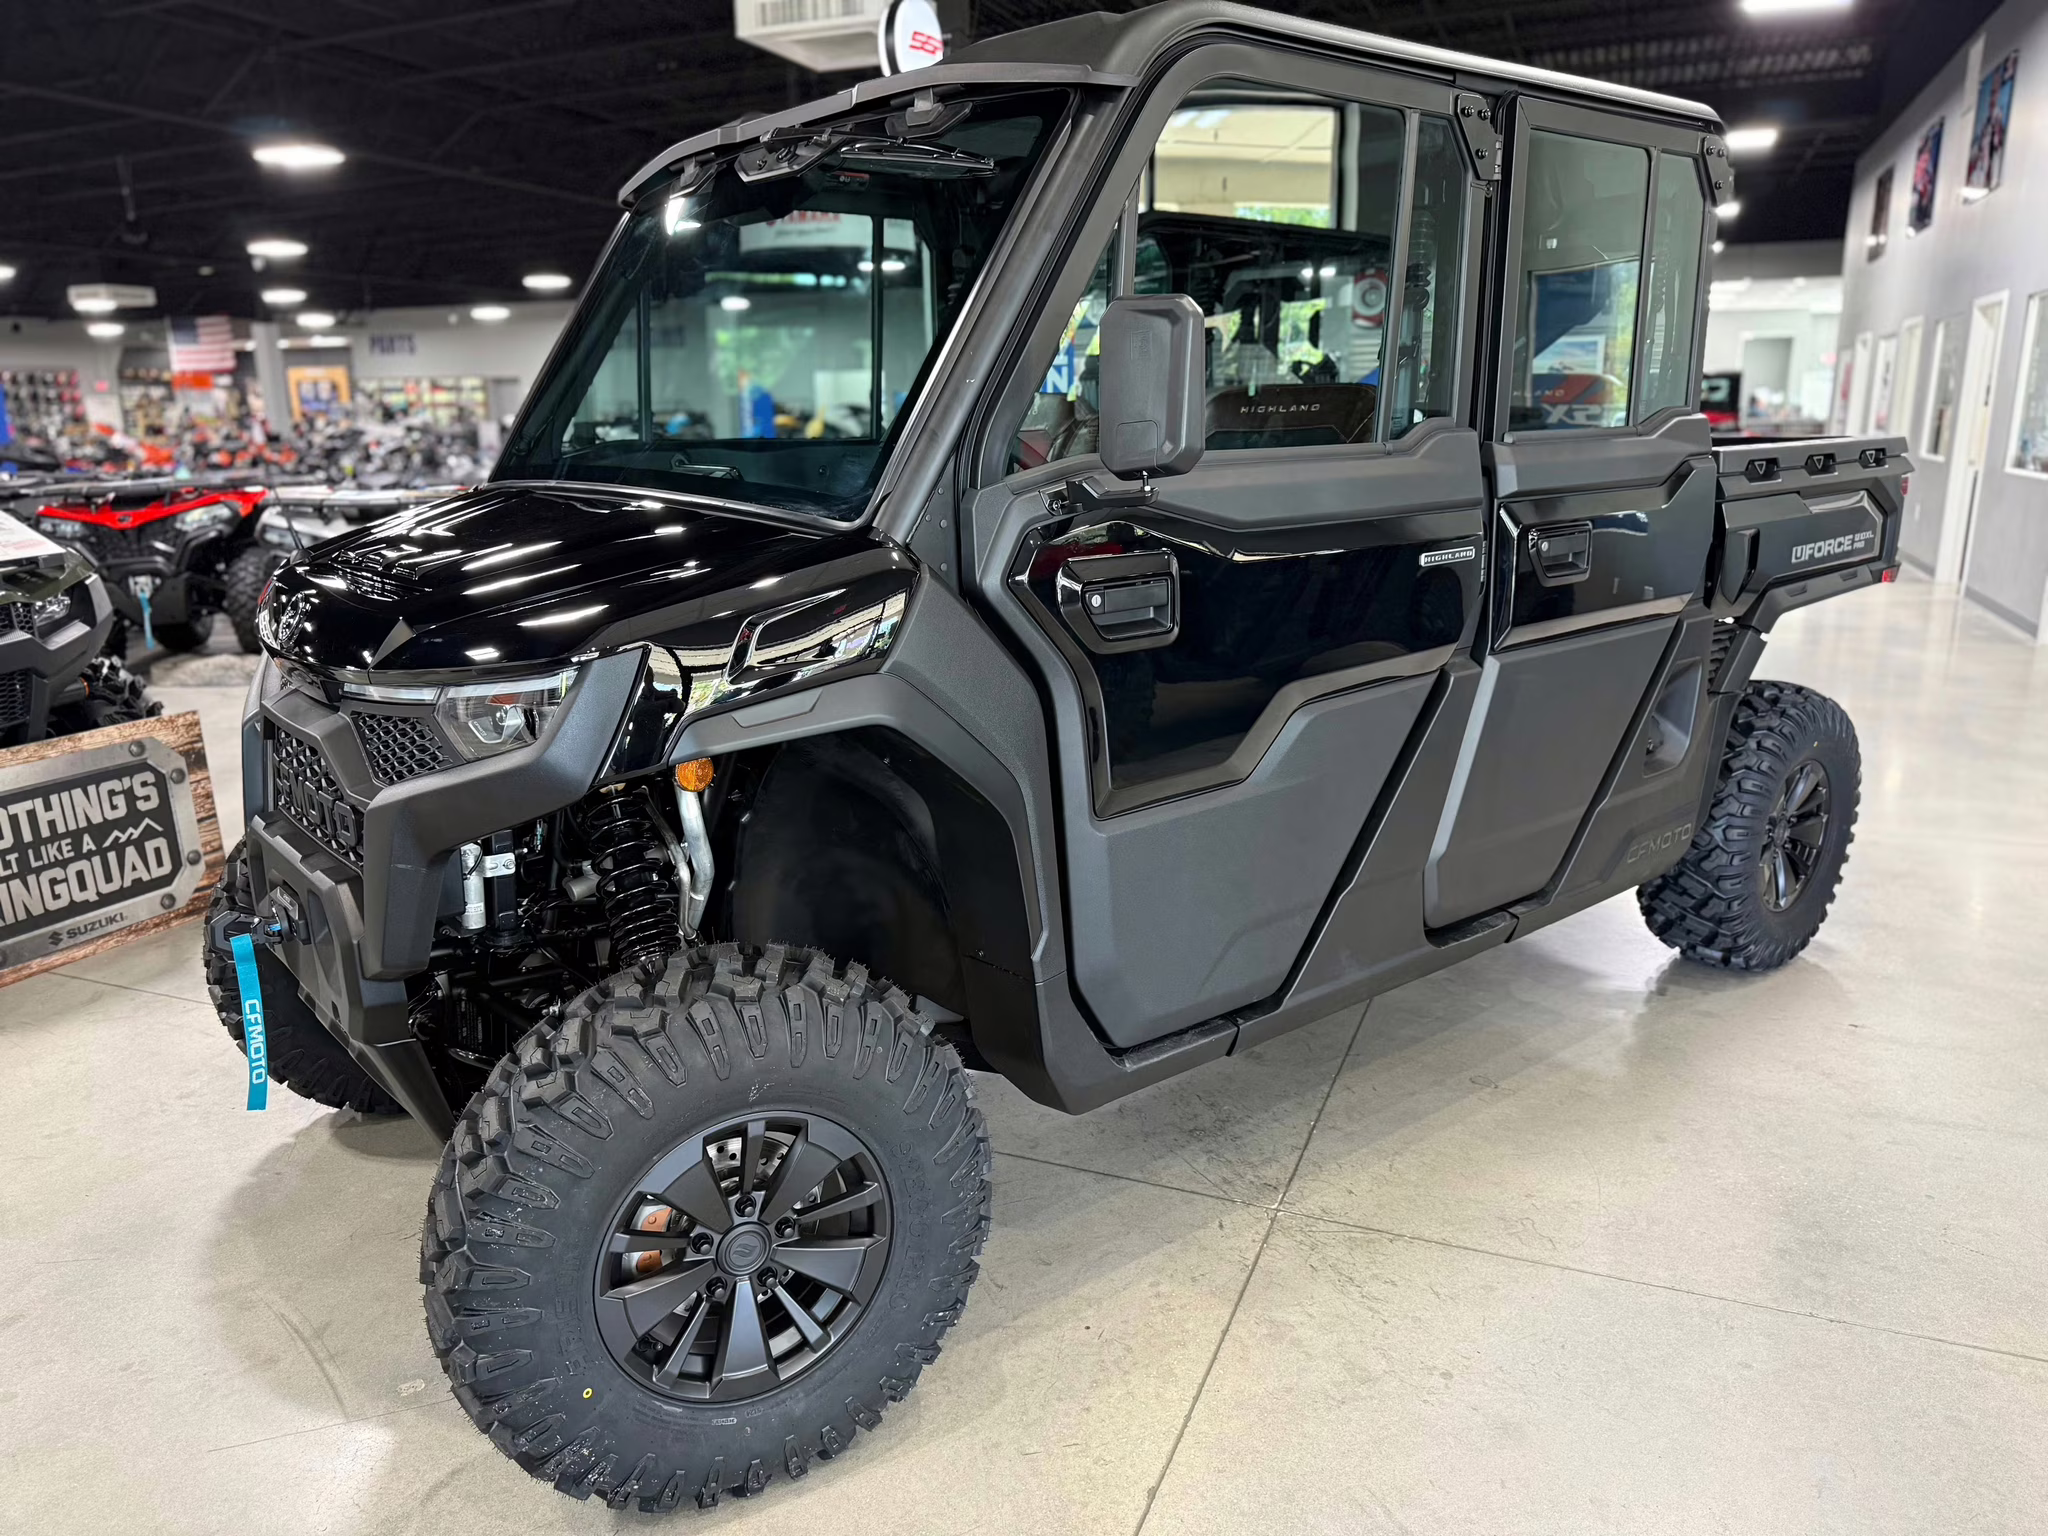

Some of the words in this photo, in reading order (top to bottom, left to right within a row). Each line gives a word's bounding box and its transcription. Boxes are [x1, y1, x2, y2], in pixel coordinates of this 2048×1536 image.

[1240, 403, 1321, 414] HIGHLAND
[1424, 550, 1473, 563] HIGHLAND
[1791, 534, 1854, 564] UFORCE
[28, 838, 75, 869] LIKE
[82, 833, 97, 854] A
[1627, 823, 1692, 864] CFMOTO
[0, 837, 173, 927] INGQUAD
[66, 912, 125, 939] SUZUKI
[245, 999, 266, 1085] CFMOTO
